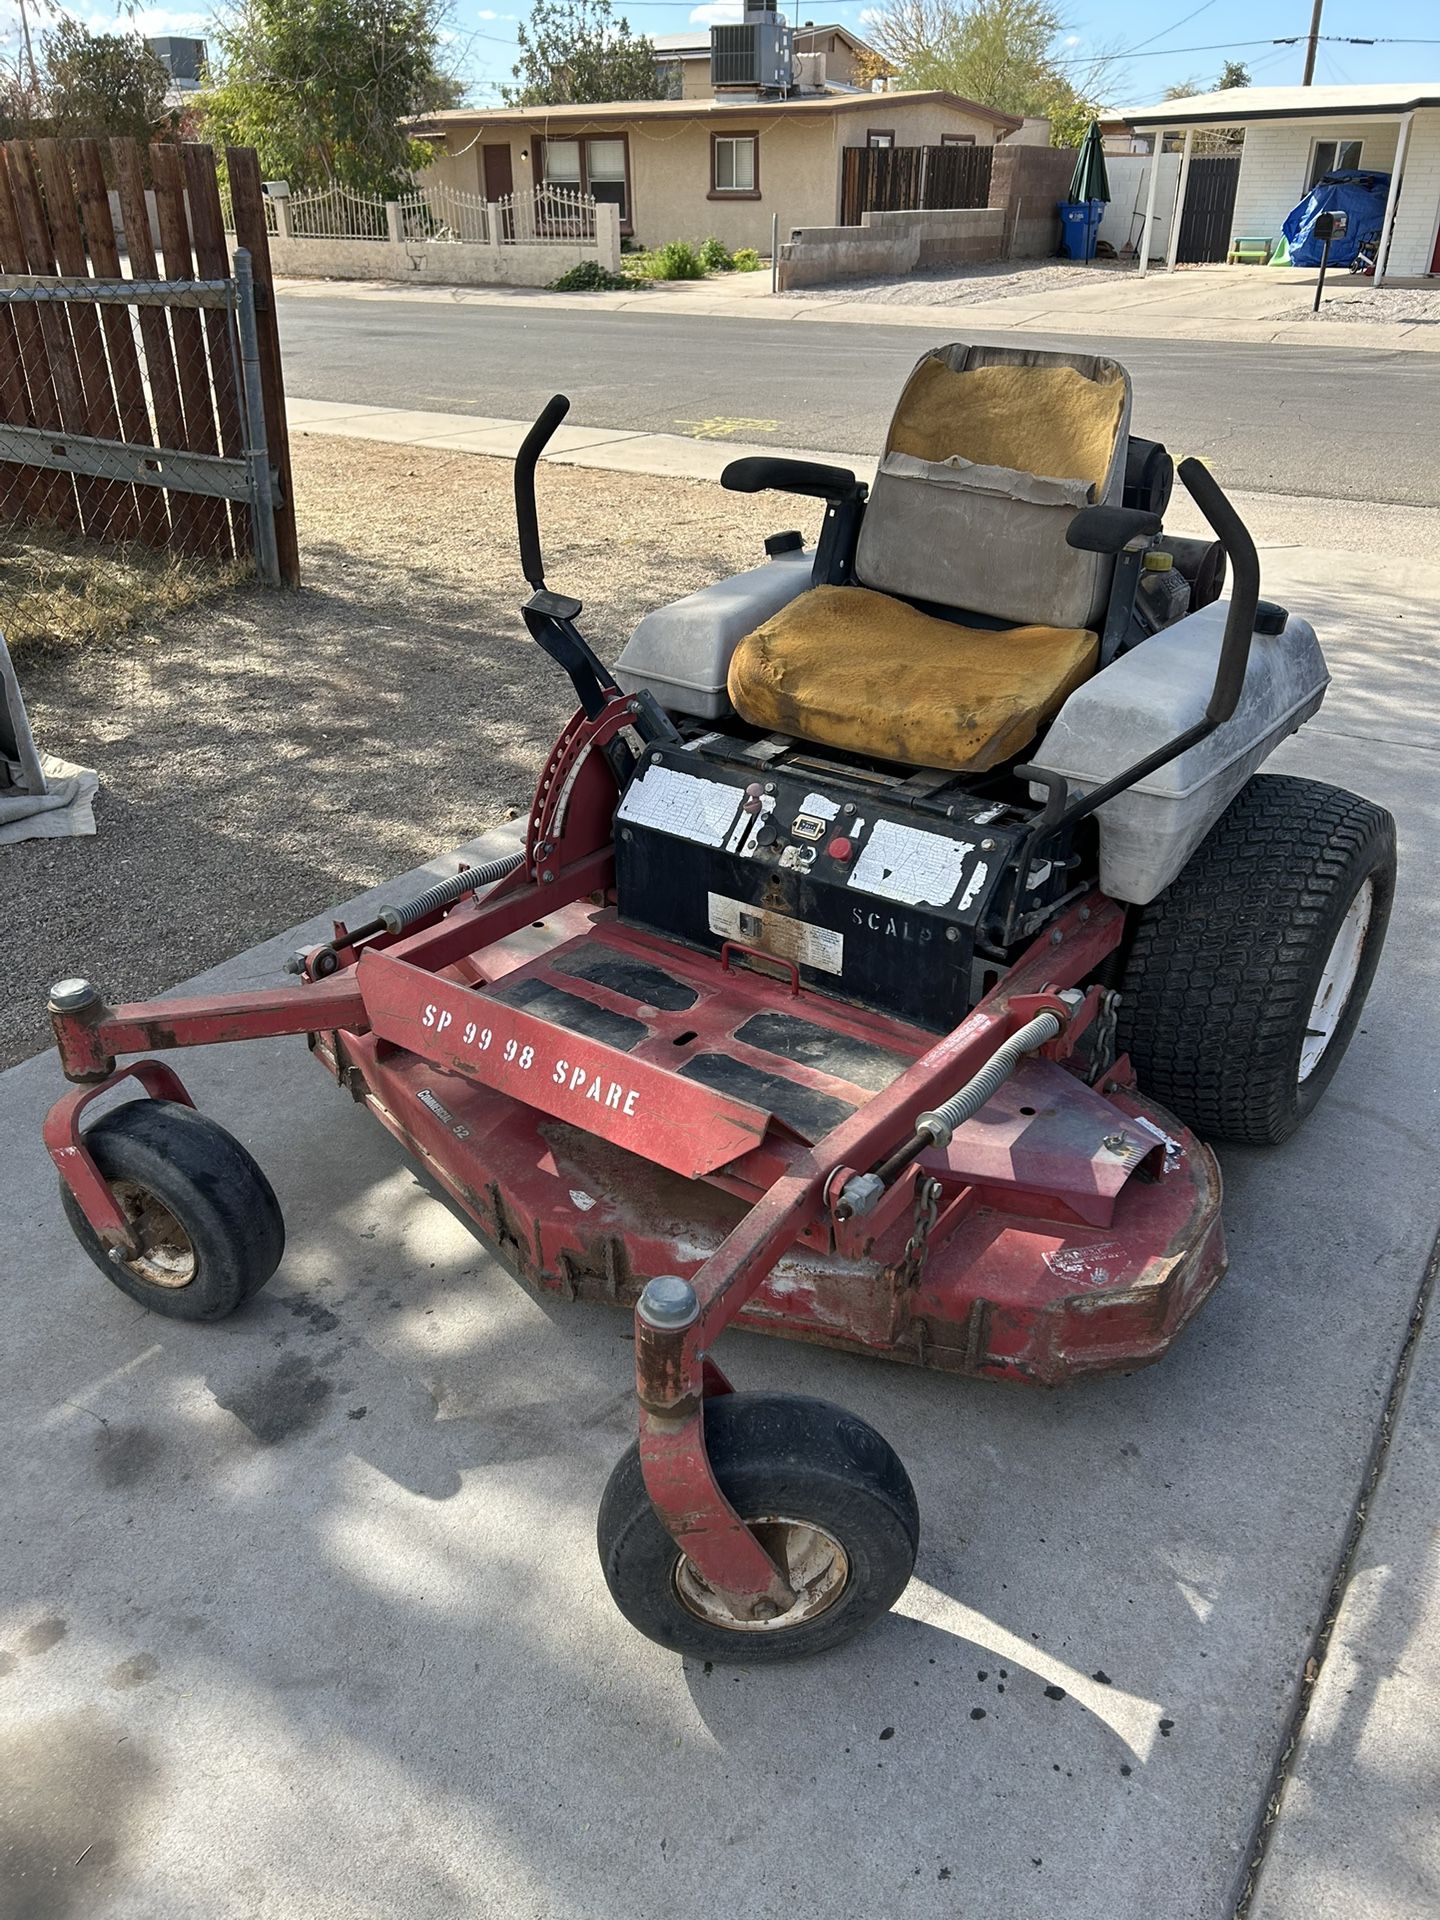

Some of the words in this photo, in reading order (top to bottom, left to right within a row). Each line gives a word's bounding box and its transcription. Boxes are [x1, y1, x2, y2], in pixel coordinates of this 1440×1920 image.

[422, 1004, 452, 1032] SP
[463, 1022, 492, 1050] 99
[503, 1039, 534, 1069] 98
[553, 1060, 640, 1116] SPARE
[452, 1125, 470, 1139] 52
